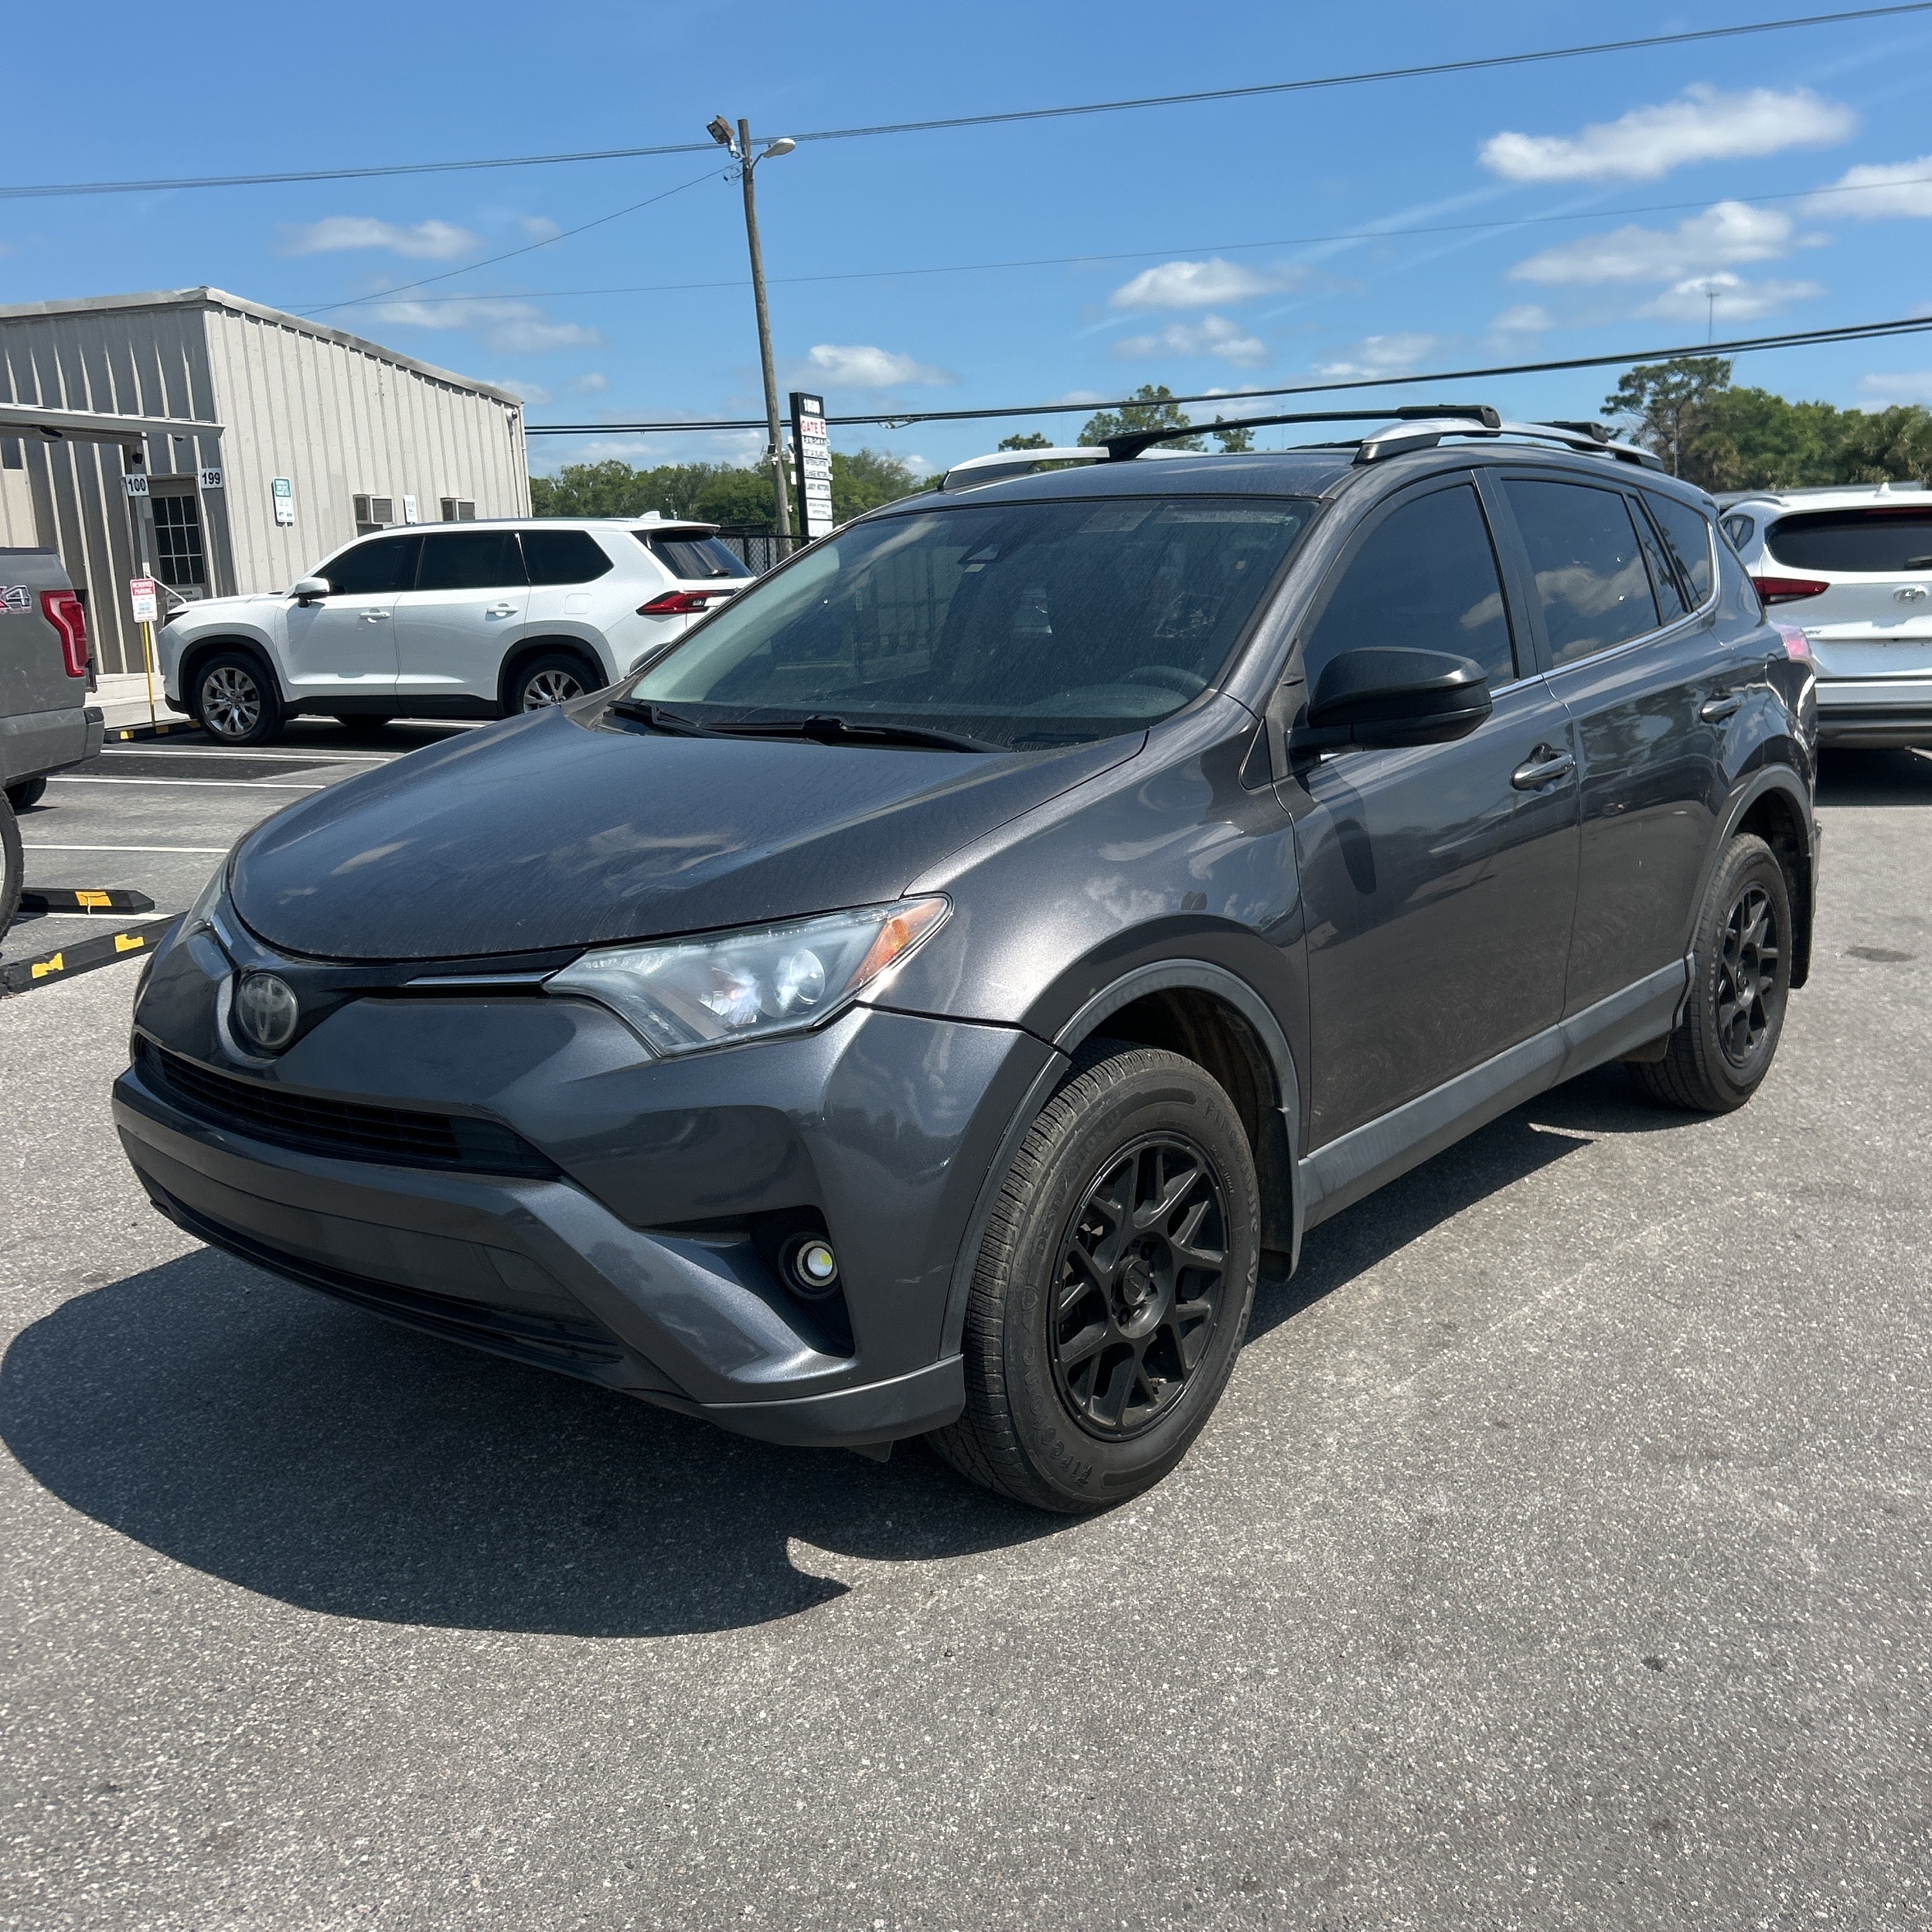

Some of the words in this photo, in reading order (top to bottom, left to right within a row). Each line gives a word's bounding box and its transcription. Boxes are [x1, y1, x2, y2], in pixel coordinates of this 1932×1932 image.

[801, 420, 819, 434] GATE
[820, 421, 826, 434] E
[128, 478, 146, 492] 100
[202, 472, 220, 485] 199
